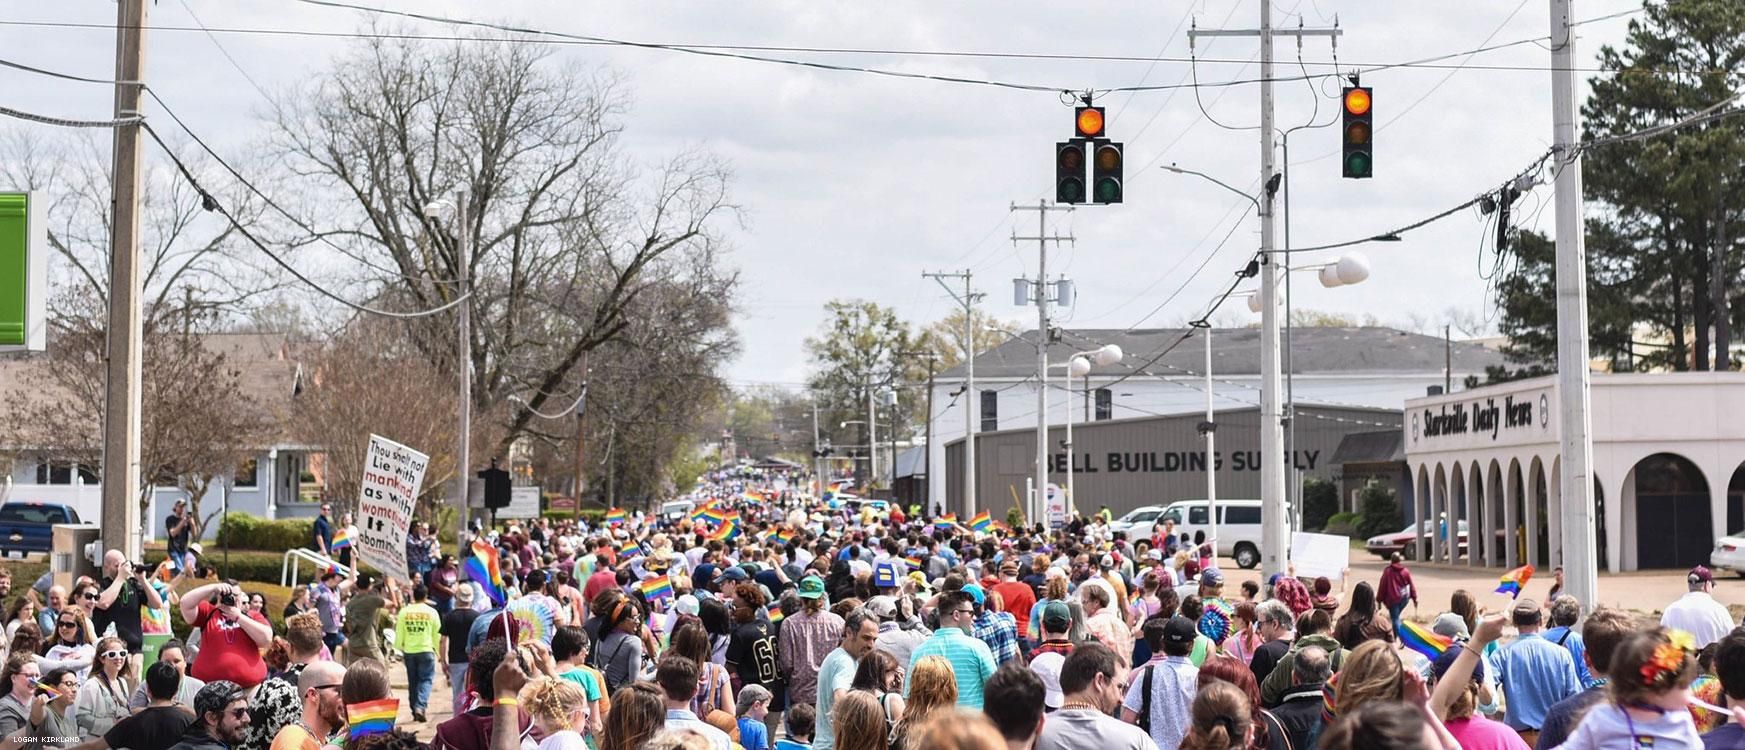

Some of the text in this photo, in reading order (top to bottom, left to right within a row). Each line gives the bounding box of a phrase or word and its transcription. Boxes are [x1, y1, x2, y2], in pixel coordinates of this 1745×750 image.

[1424, 395, 1533, 441] Starkville Daily News
[371, 440, 391, 458] Thou
[411, 460, 425, 473] not
[373, 456, 415, 484] Lie with
[1107, 452, 1223, 473] BUILDING
[1231, 450, 1320, 472] SULY
[365, 487, 411, 515] as with
[368, 516, 400, 543] It is
